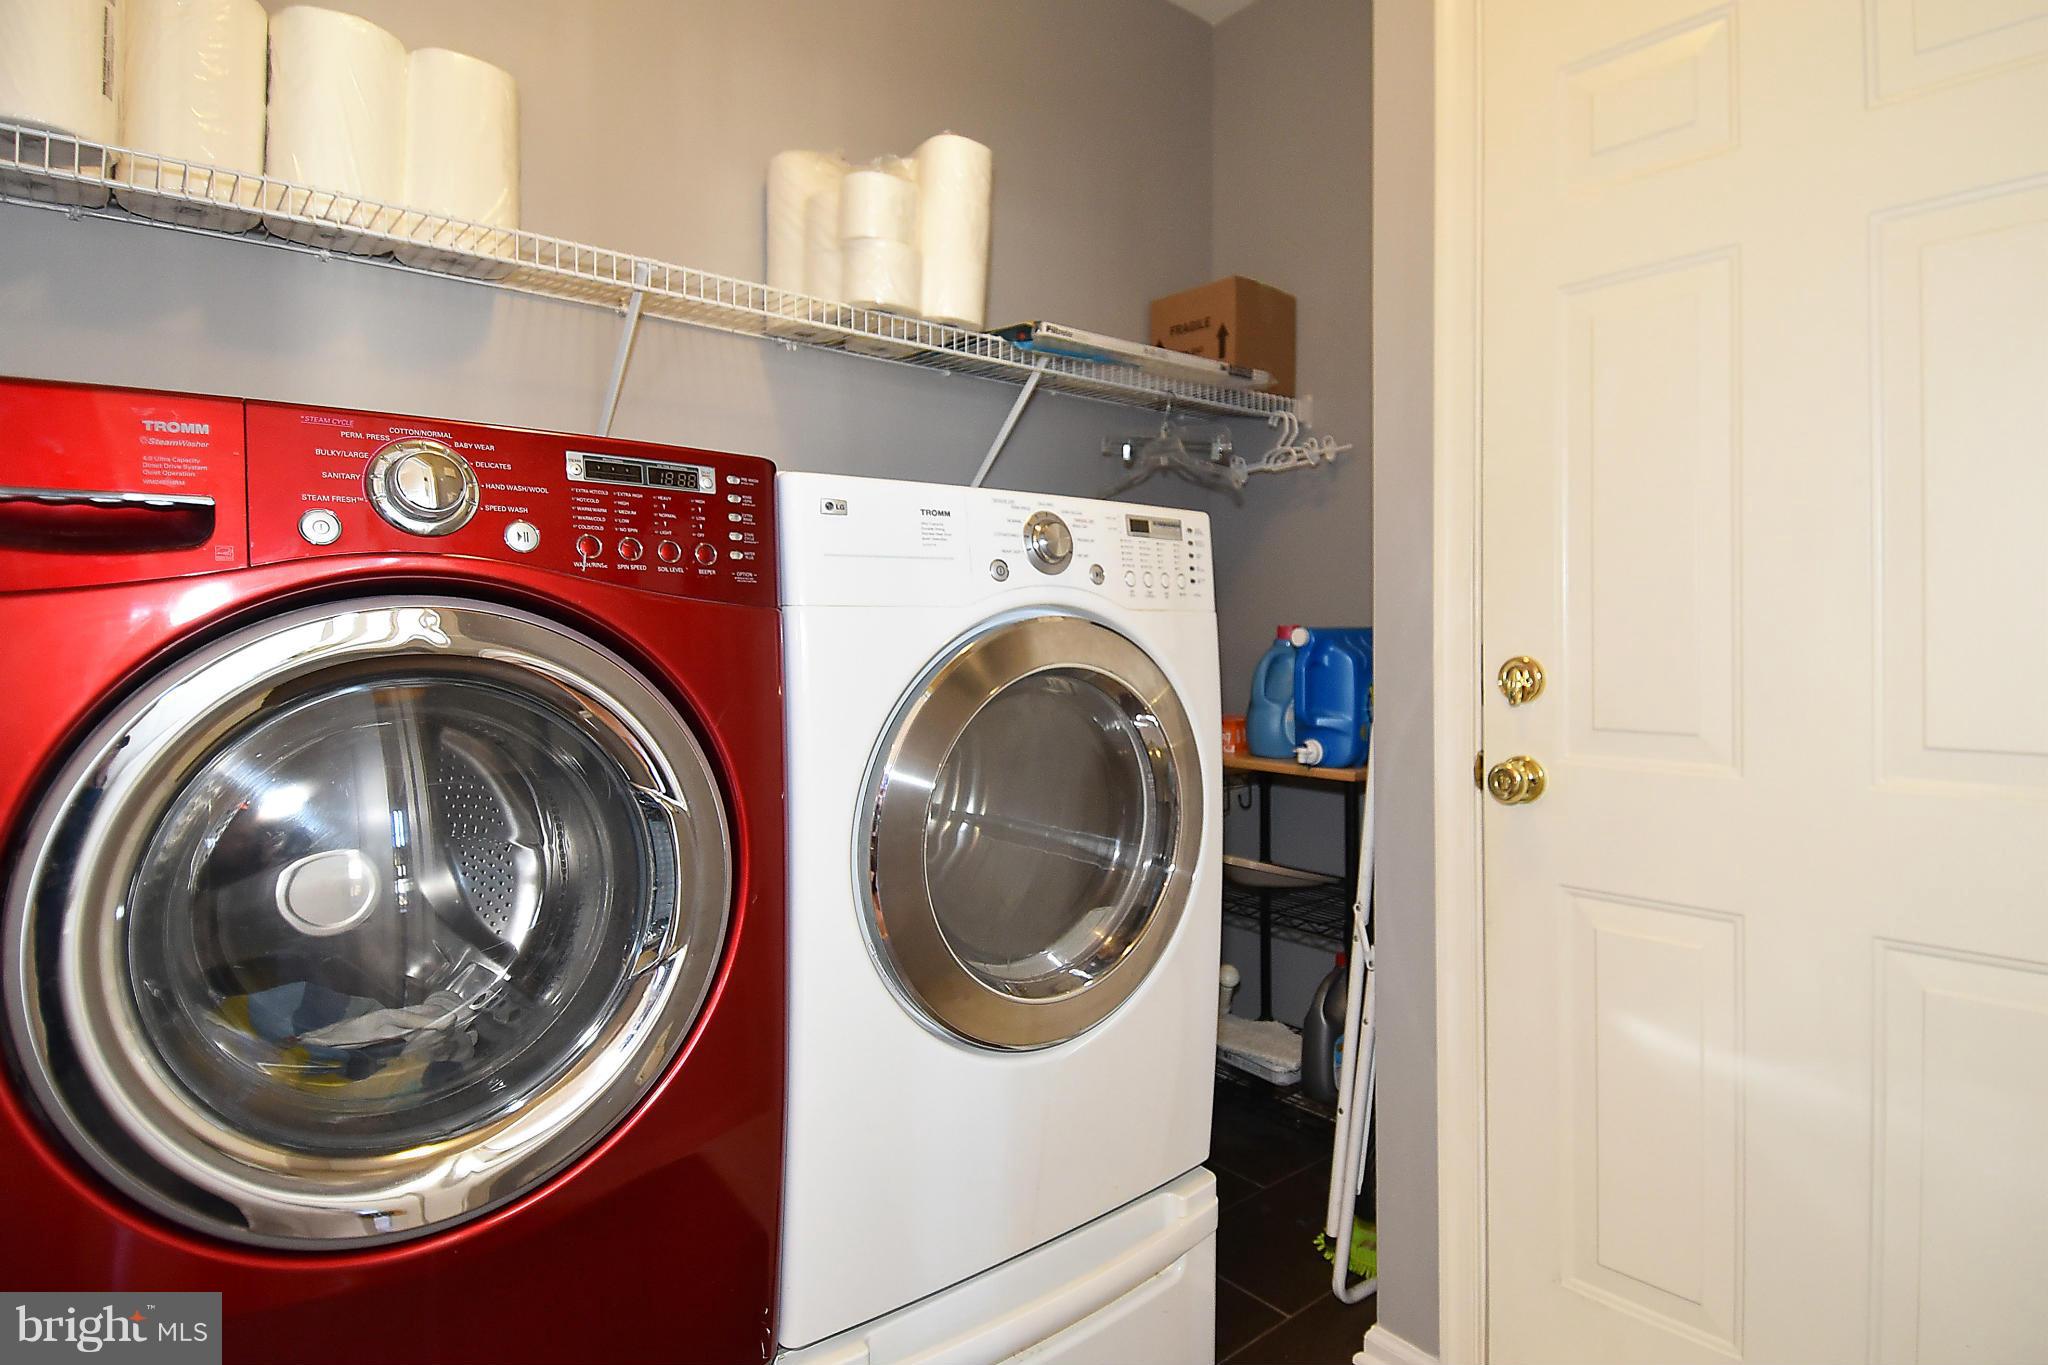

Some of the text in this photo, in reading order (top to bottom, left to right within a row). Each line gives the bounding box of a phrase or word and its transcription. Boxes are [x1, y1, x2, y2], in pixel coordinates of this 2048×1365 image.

[1169, 316, 1211, 336] FRAGILE
[142, 420, 209, 435] TROMM
[389, 427, 453, 439] COTTON/NORMAL
[340, 431, 364, 439] PERM.
[148, 437, 209, 448] SteamWasher
[454, 442, 495, 451] BABY WEAR
[315, 448, 369, 459] BULKY/LARGE
[475, 461, 512, 471] DELICATES
[321, 472, 361, 480] SANITARY
[485, 483, 549, 494] HAND WASH/WOOL
[920, 508, 951, 517] TROMM
